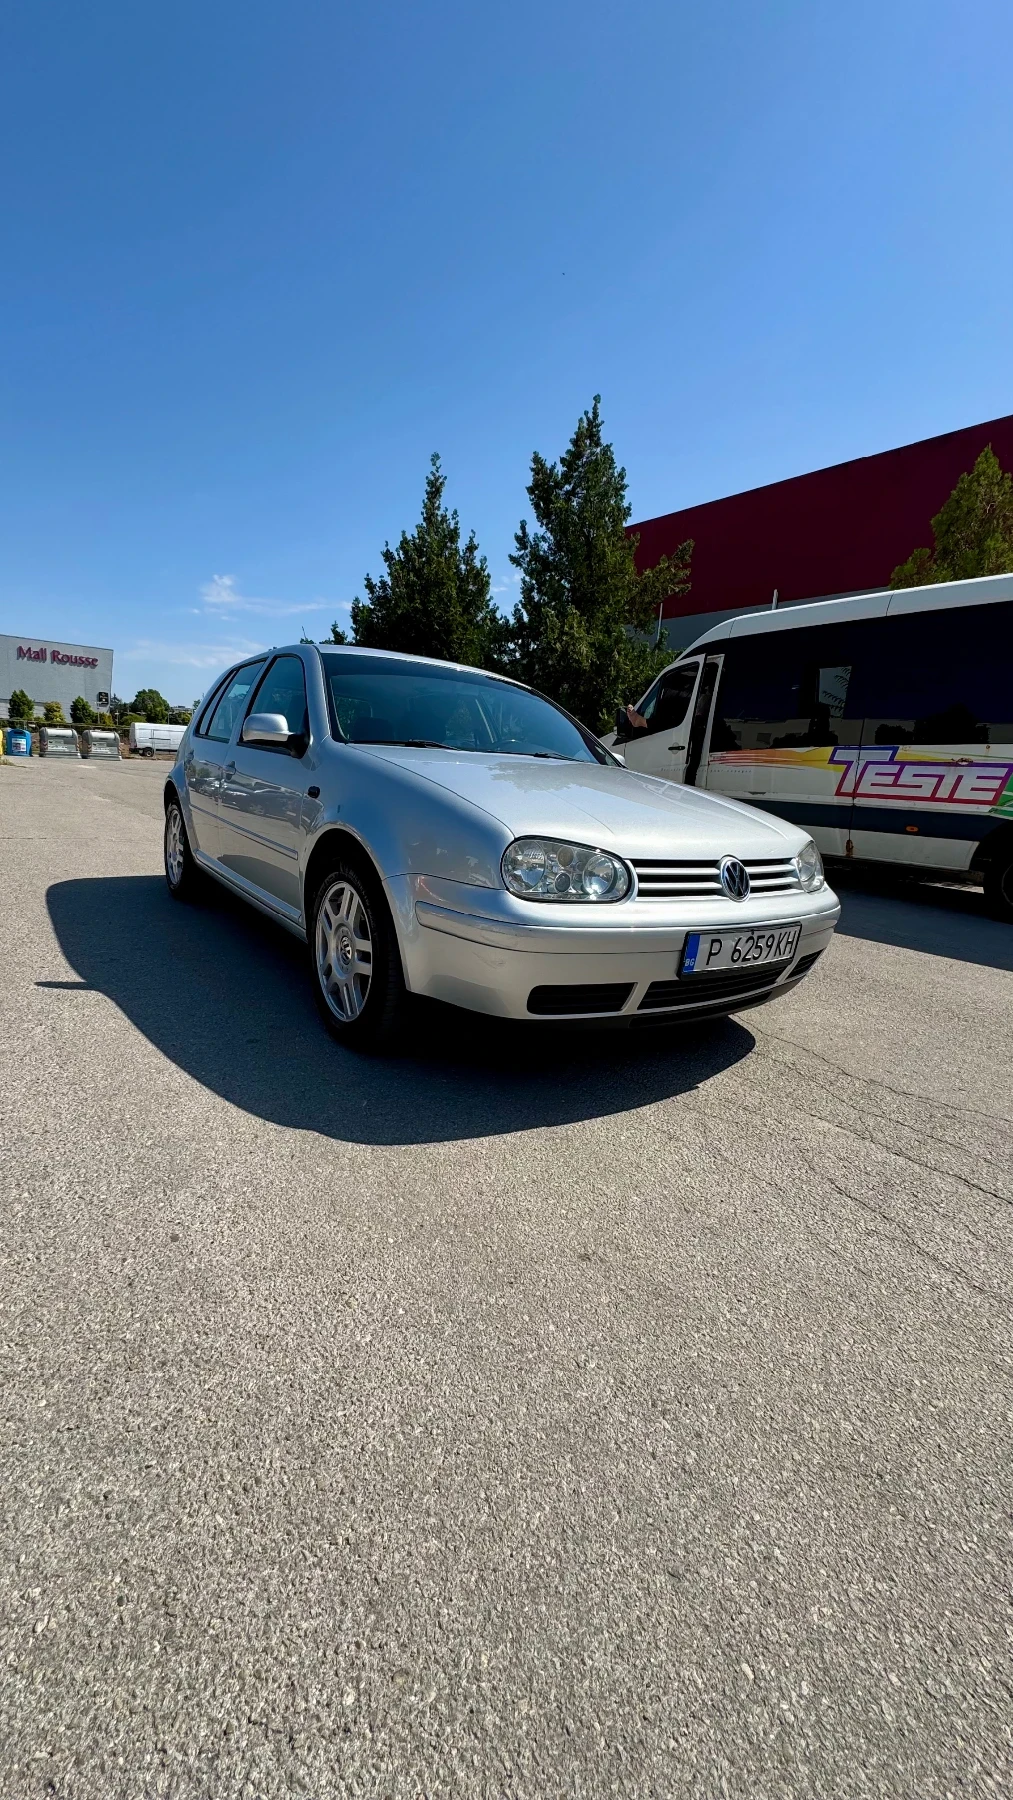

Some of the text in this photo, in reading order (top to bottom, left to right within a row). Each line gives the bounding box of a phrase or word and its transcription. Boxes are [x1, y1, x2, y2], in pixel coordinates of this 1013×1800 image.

[18, 645, 99, 667] Mall Rousse
[828, 745, 1013, 806] TESTE
[722, 859, 749, 900] VW
[684, 958, 695, 967] BG
